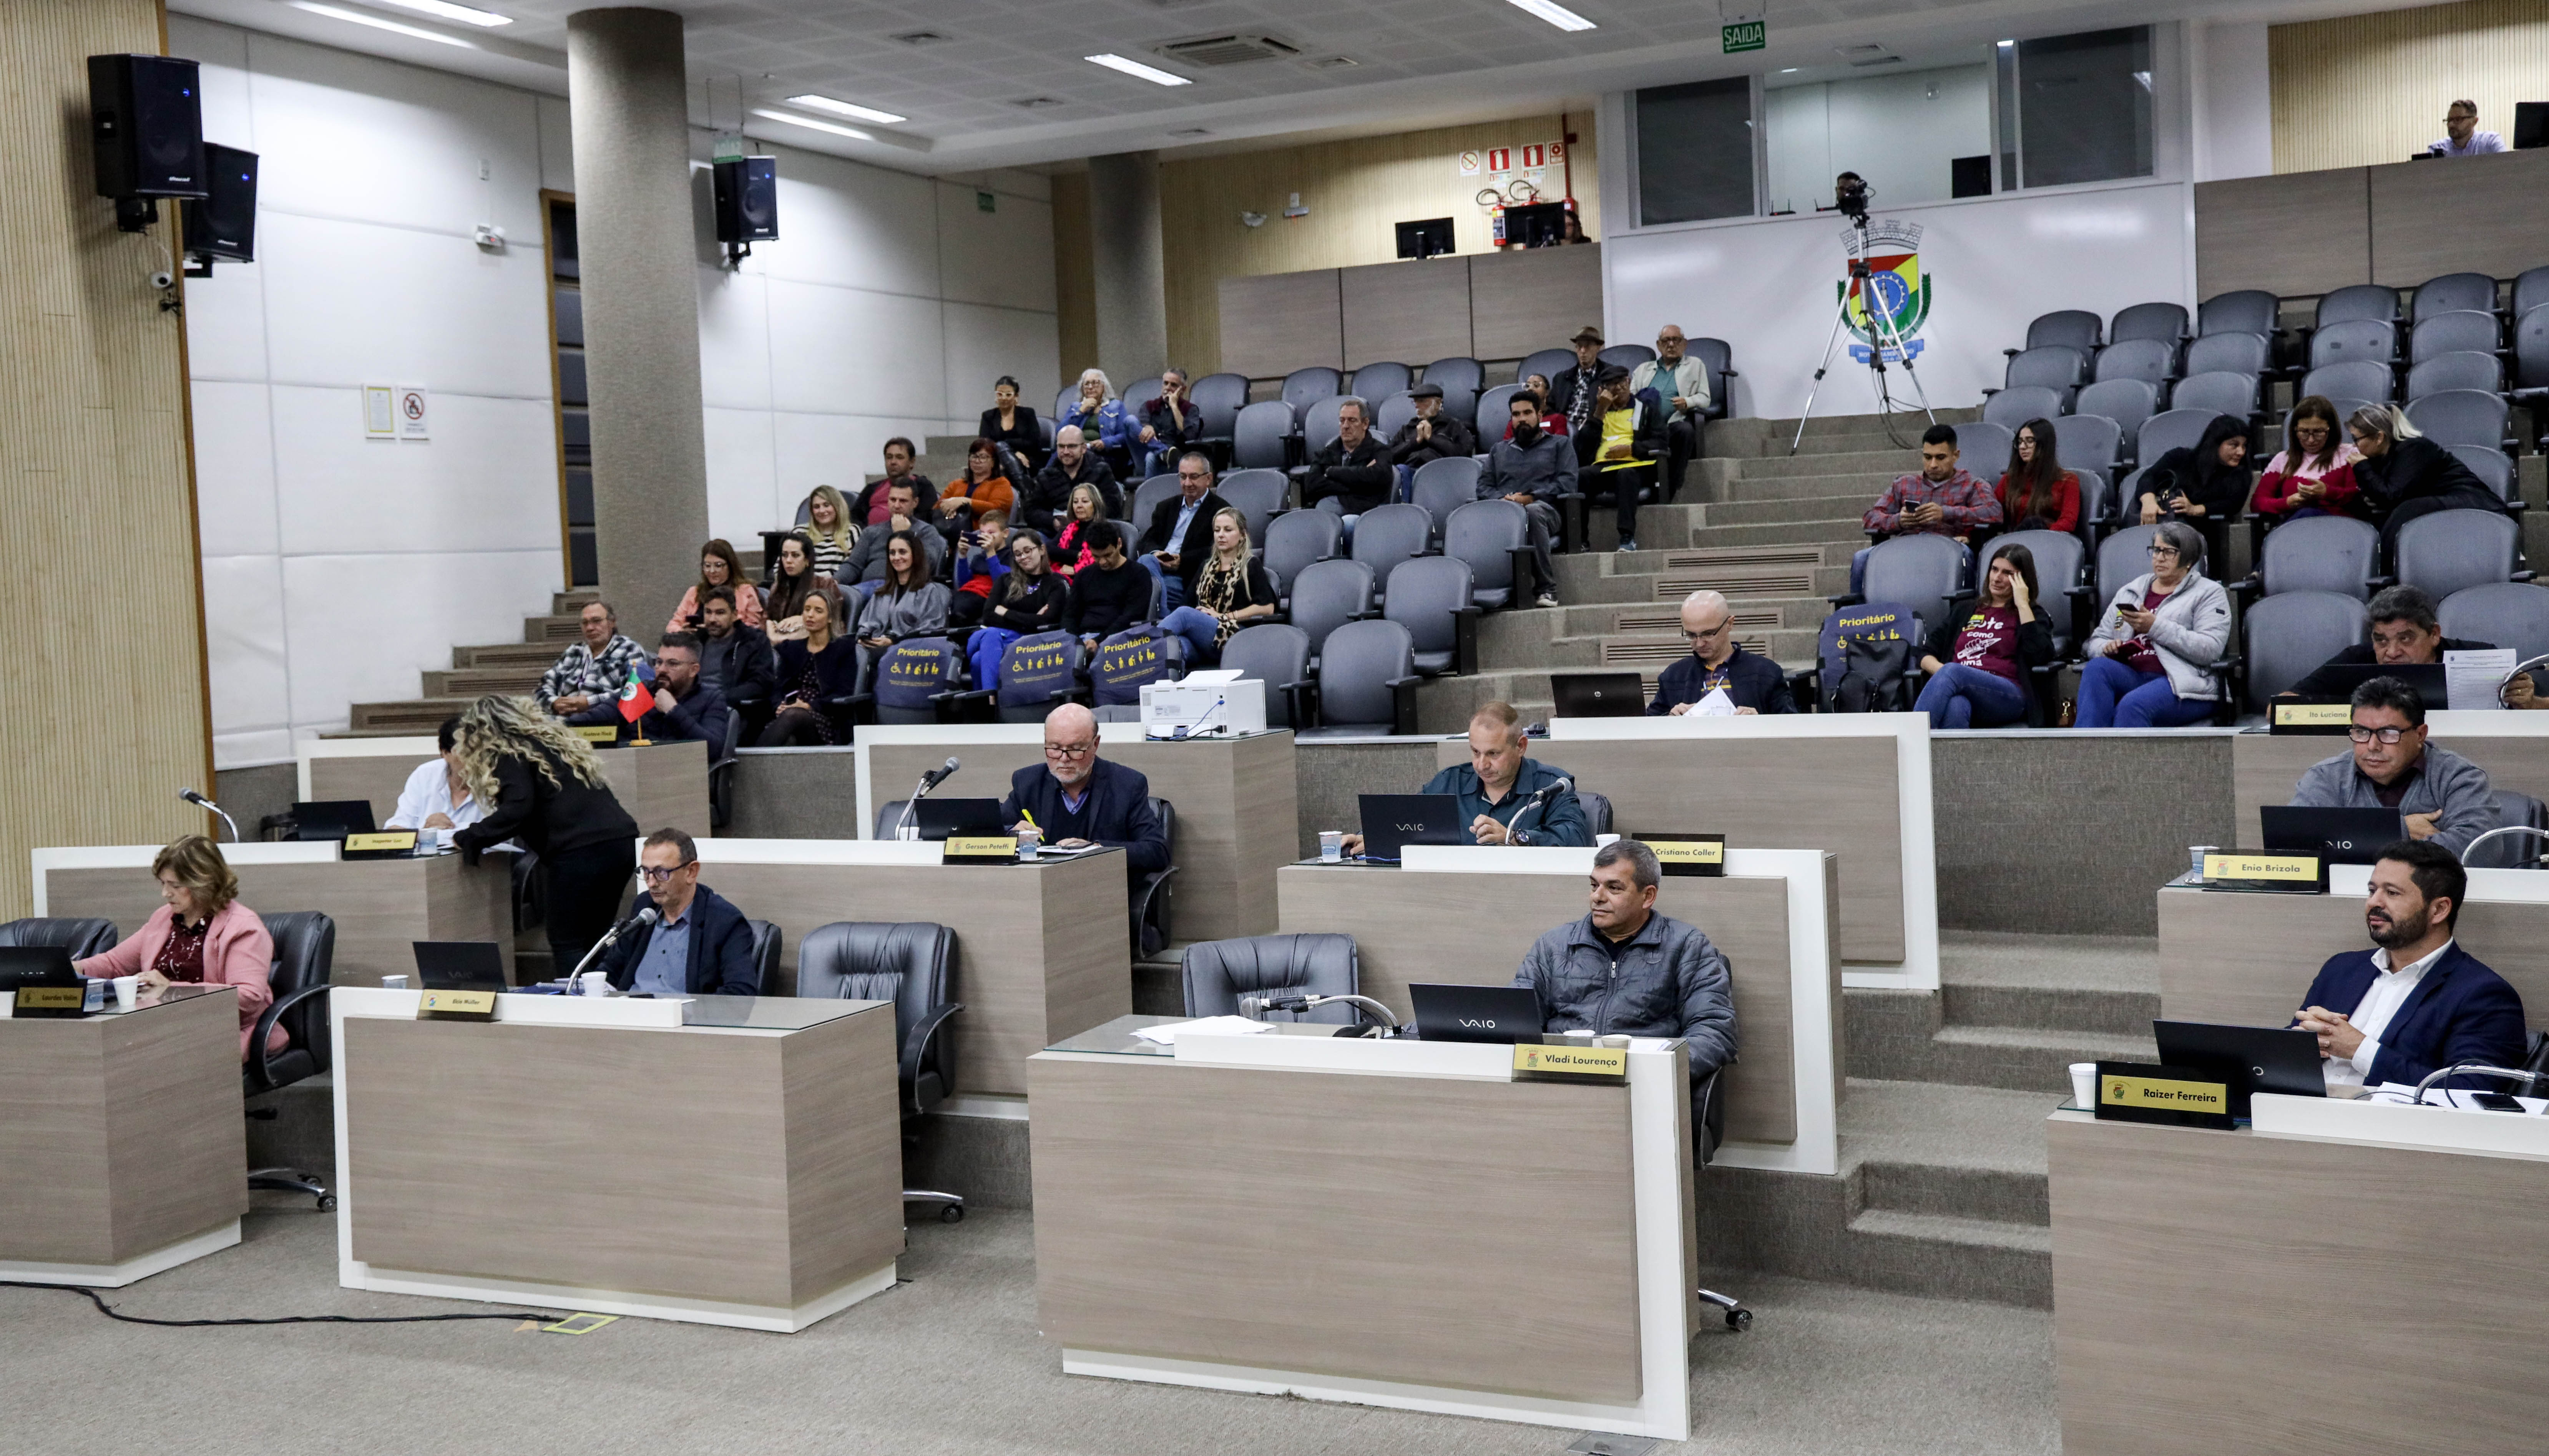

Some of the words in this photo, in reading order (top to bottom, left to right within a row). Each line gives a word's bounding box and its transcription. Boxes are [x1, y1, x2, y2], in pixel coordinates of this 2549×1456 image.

[1839, 614, 1895, 627] Prioritário
[1016, 641, 1062, 654] Prioritário
[1104, 636, 1151, 653] Prioritário
[897, 648, 940, 657] Prioritário
[2265, 864, 2300, 872] Brizola
[1459, 1019, 1496, 1029] VAIO
[1545, 1054, 1570, 1063] Vladi
[1573, 1056, 1617, 1068] Lourenço
[2144, 1088, 2175, 1099] Raizer
[2177, 1091, 2217, 1103] Ferreira
